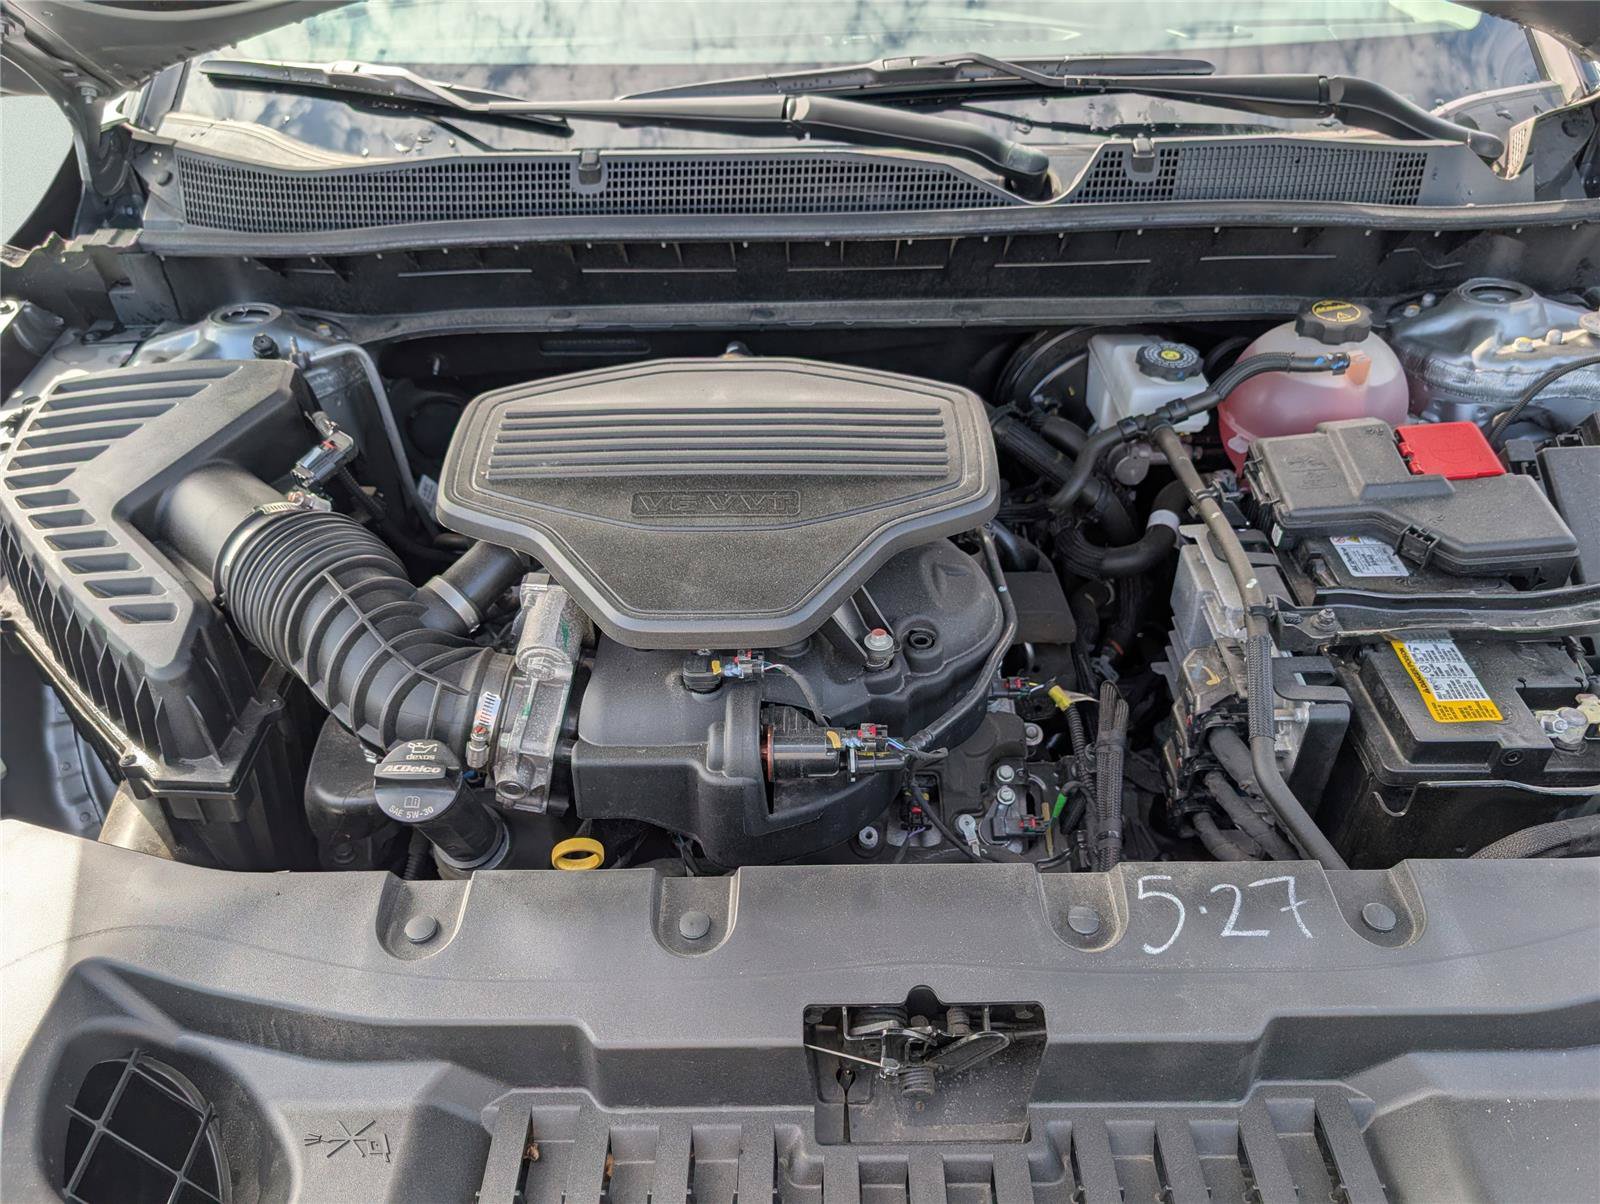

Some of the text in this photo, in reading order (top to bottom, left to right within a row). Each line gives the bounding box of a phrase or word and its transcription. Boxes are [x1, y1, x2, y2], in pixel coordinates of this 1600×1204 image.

[704, 494, 793, 512] VVT
[406, 753, 436, 761] dexos
[381, 764, 442, 774] ACDelco
[388, 804, 434, 819] SAE 5W-30
